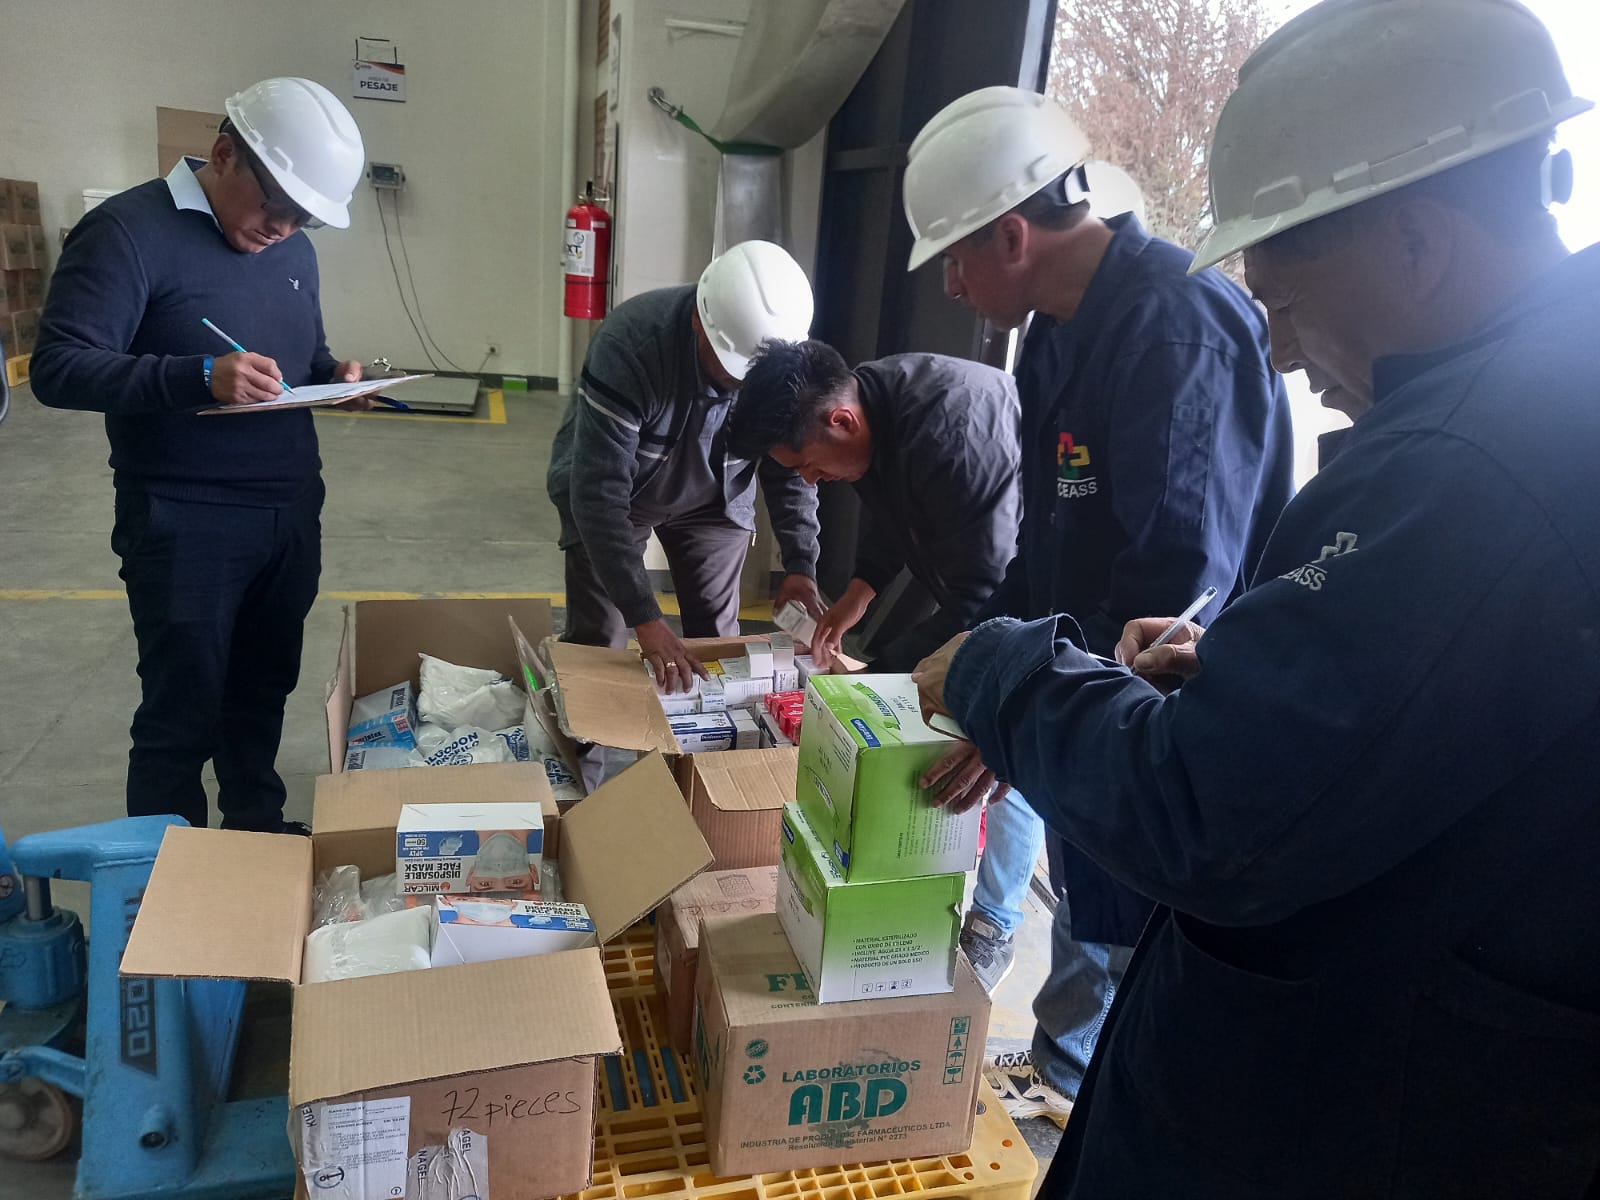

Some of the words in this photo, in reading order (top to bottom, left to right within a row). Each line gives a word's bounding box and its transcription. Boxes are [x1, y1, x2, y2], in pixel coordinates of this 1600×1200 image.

[360, 80, 399, 92] PESAJE
[404, 863, 434, 872] MASK
[436, 862, 462, 871] FACE
[404, 870, 461, 880] DISPOSABLE
[404, 885, 440, 893] MILCAR
[782, 1059, 921, 1083] LABORATORIOS
[441, 1087, 480, 1127] 72
[484, 1091, 582, 1128] pieces
[787, 1077, 908, 1126] ABD
[741, 1137, 788, 1149] INDUSTRIA
[788, 1136, 801, 1144] DE
